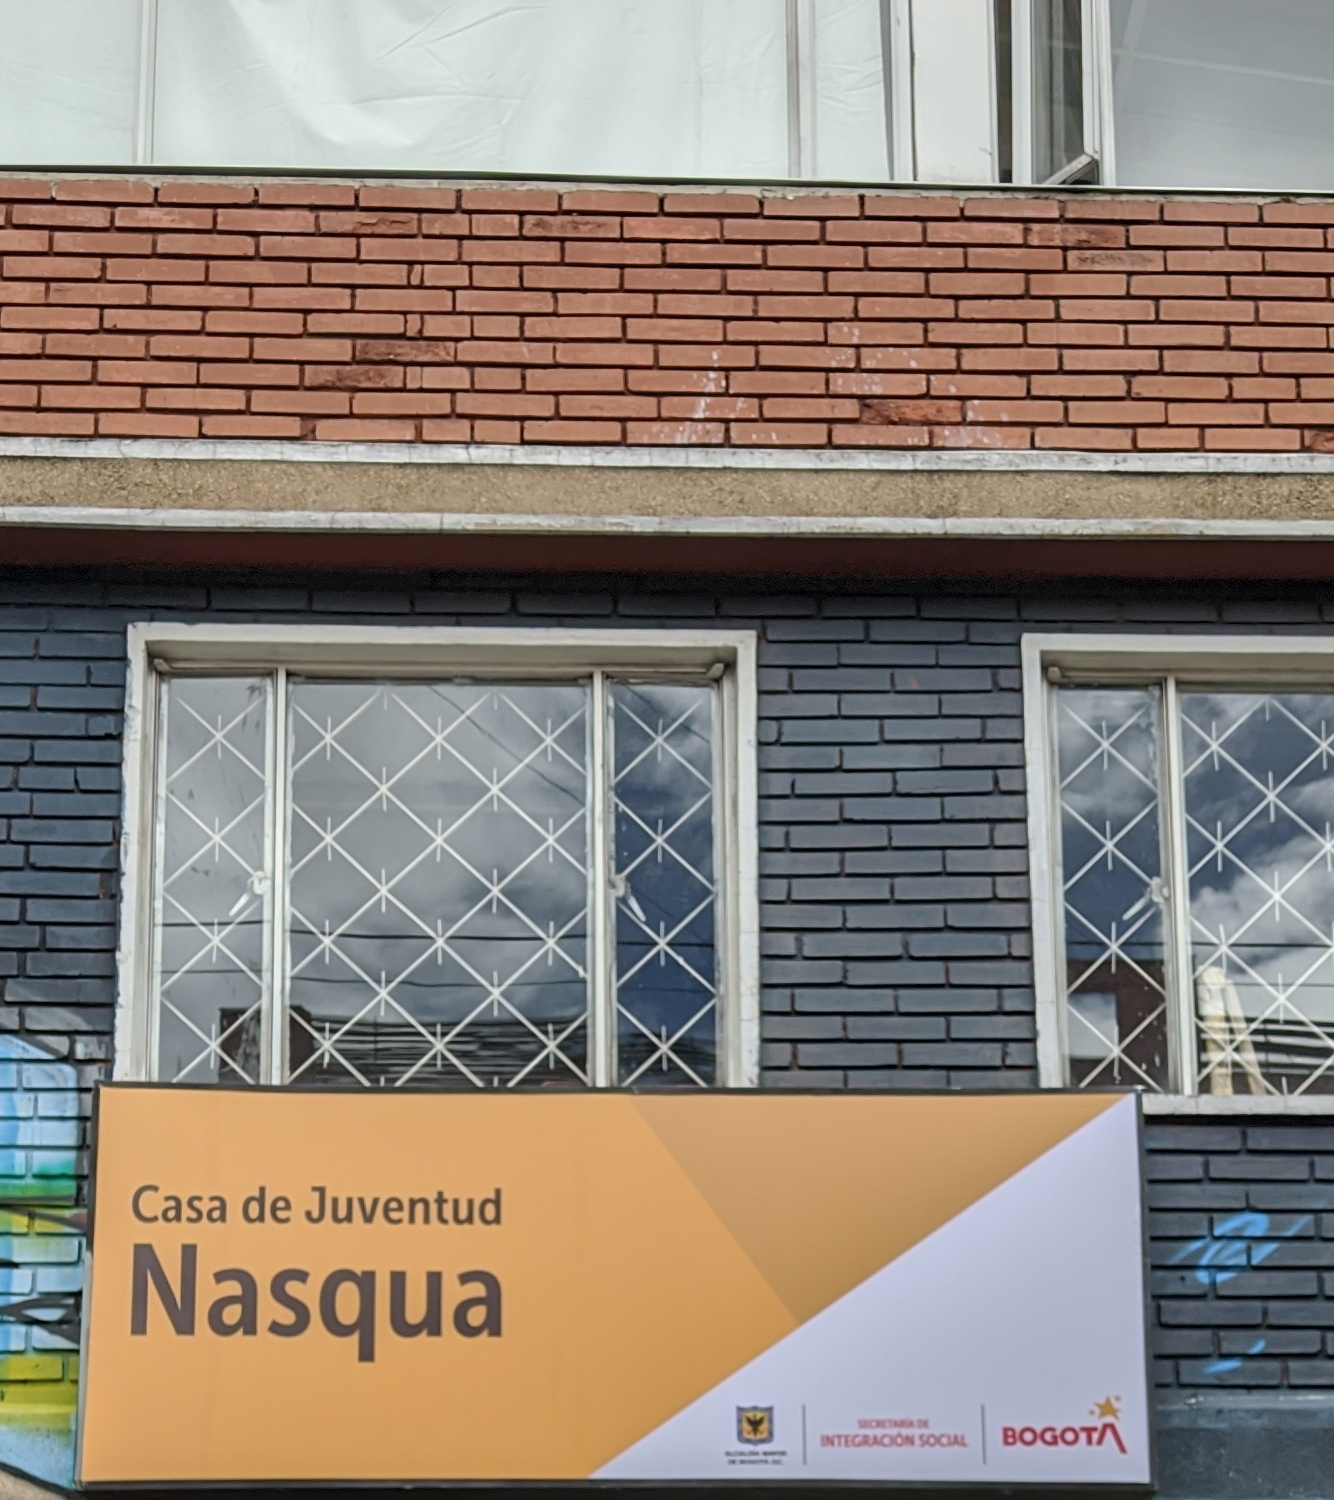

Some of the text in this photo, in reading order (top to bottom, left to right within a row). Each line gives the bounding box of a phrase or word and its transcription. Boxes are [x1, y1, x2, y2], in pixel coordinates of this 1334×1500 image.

[132, 1184, 502, 1225] Casa de Juventud
[130, 1243, 503, 1363] Nasqua
[917, 1419, 930, 1429] DE
[820, 1432, 970, 1448] INTEGRACIÓN SOCIAL
